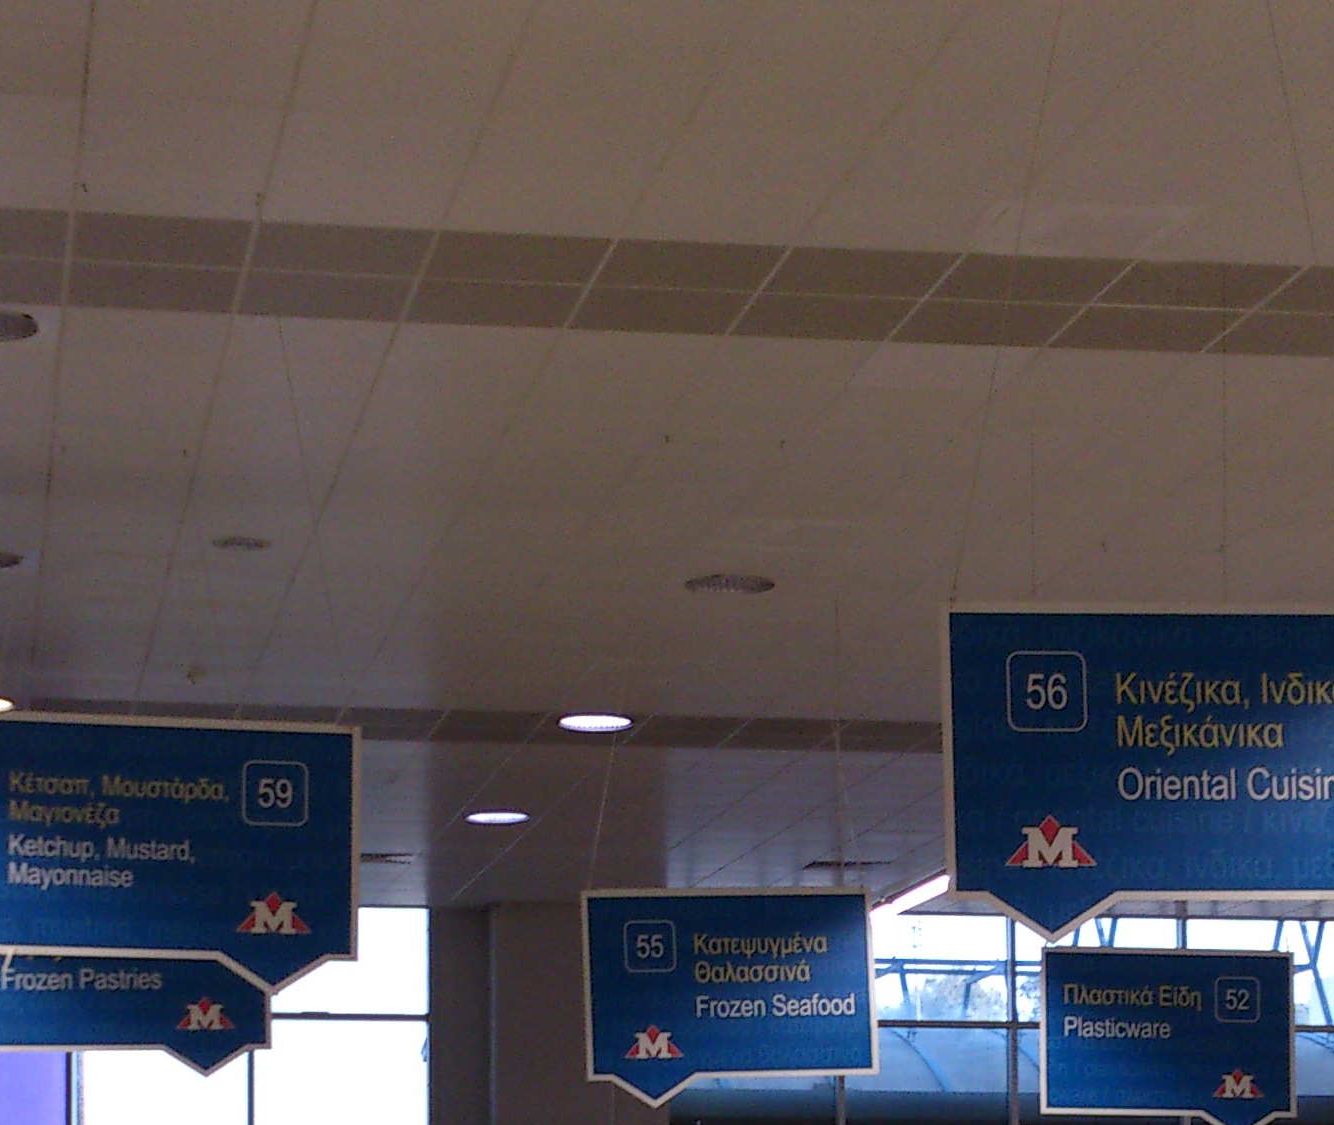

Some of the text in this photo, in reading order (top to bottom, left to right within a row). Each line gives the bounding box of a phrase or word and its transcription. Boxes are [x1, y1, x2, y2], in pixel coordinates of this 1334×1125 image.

[1026, 673, 1067, 710] 56
[1116, 672, 1250, 713] Κινέζικα,
[1116, 715, 1284, 756] Μεξικάνικα
[258, 778, 293, 809] 59
[1117, 766, 1236, 801] Oriental
[8, 800, 119, 829] Μαγιονέζα
[7, 833, 195, 863] Ketchup, Mustard,
[7, 862, 134, 890] Mayonnaise
[636, 934, 664, 959] 55
[693, 932, 828, 958] Κατεψυγμένα
[1, 966, 162, 991] Frozen Pastries
[695, 960, 810, 983] Θαλασσινά
[695, 993, 856, 1018] Frozen Seafood
[1064, 984, 1202, 1011] Πλαστικά Είδη
[1225, 989, 1250, 1010] 52
[1064, 1016, 1171, 1039] Plasticware
